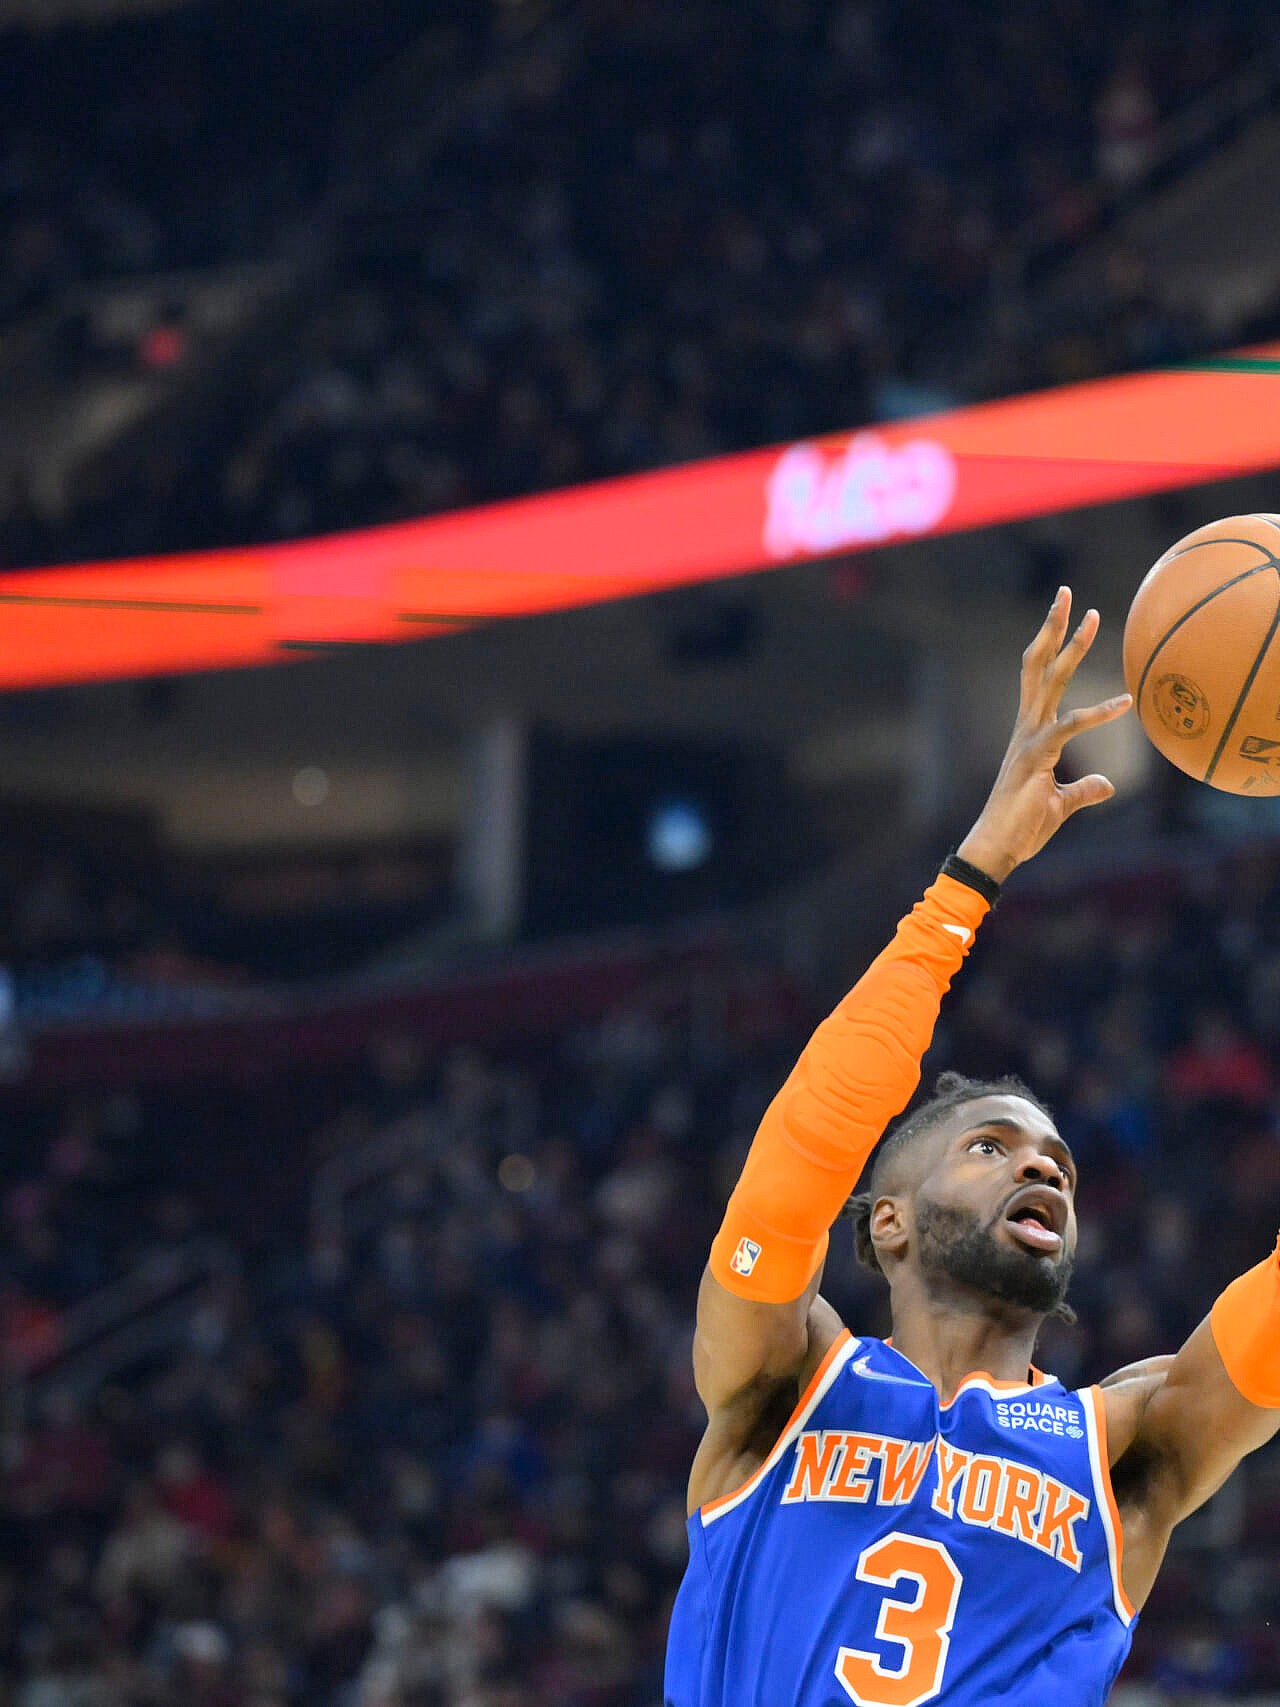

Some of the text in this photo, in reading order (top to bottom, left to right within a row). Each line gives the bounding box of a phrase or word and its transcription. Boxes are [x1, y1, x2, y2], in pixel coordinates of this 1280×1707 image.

[996, 1402, 1080, 1425] SQUARE
[998, 1416, 1065, 1436] SPACE
[780, 1431, 1090, 1573] NEW YORK
[834, 1531, 963, 1707] 3
